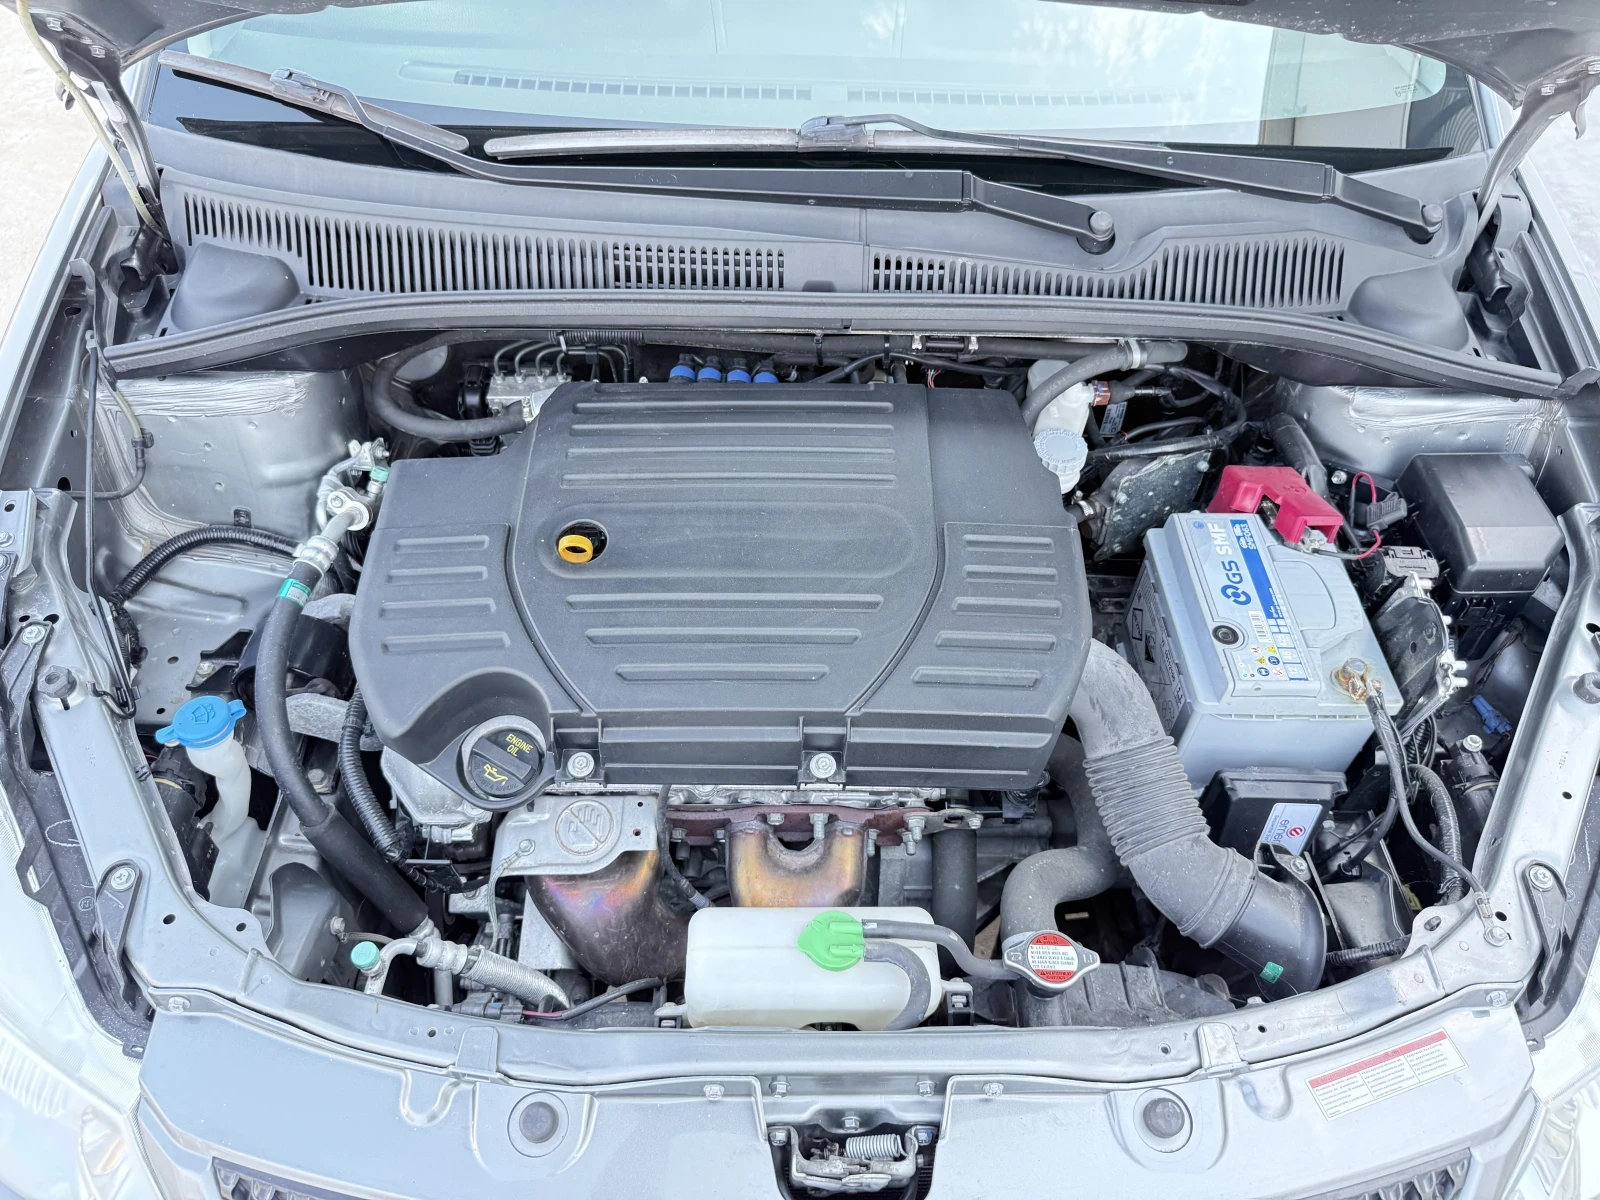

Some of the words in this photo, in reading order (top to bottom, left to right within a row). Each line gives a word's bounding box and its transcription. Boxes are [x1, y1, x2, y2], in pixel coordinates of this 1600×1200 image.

[1207, 523, 1232, 555] SMF
[1240, 523, 1257, 550] SMF063
[1221, 560, 1243, 584] GS
[505, 733, 534, 753] ENGINE
[506, 744, 517, 757] OIL
[1273, 819, 1289, 843] emer
